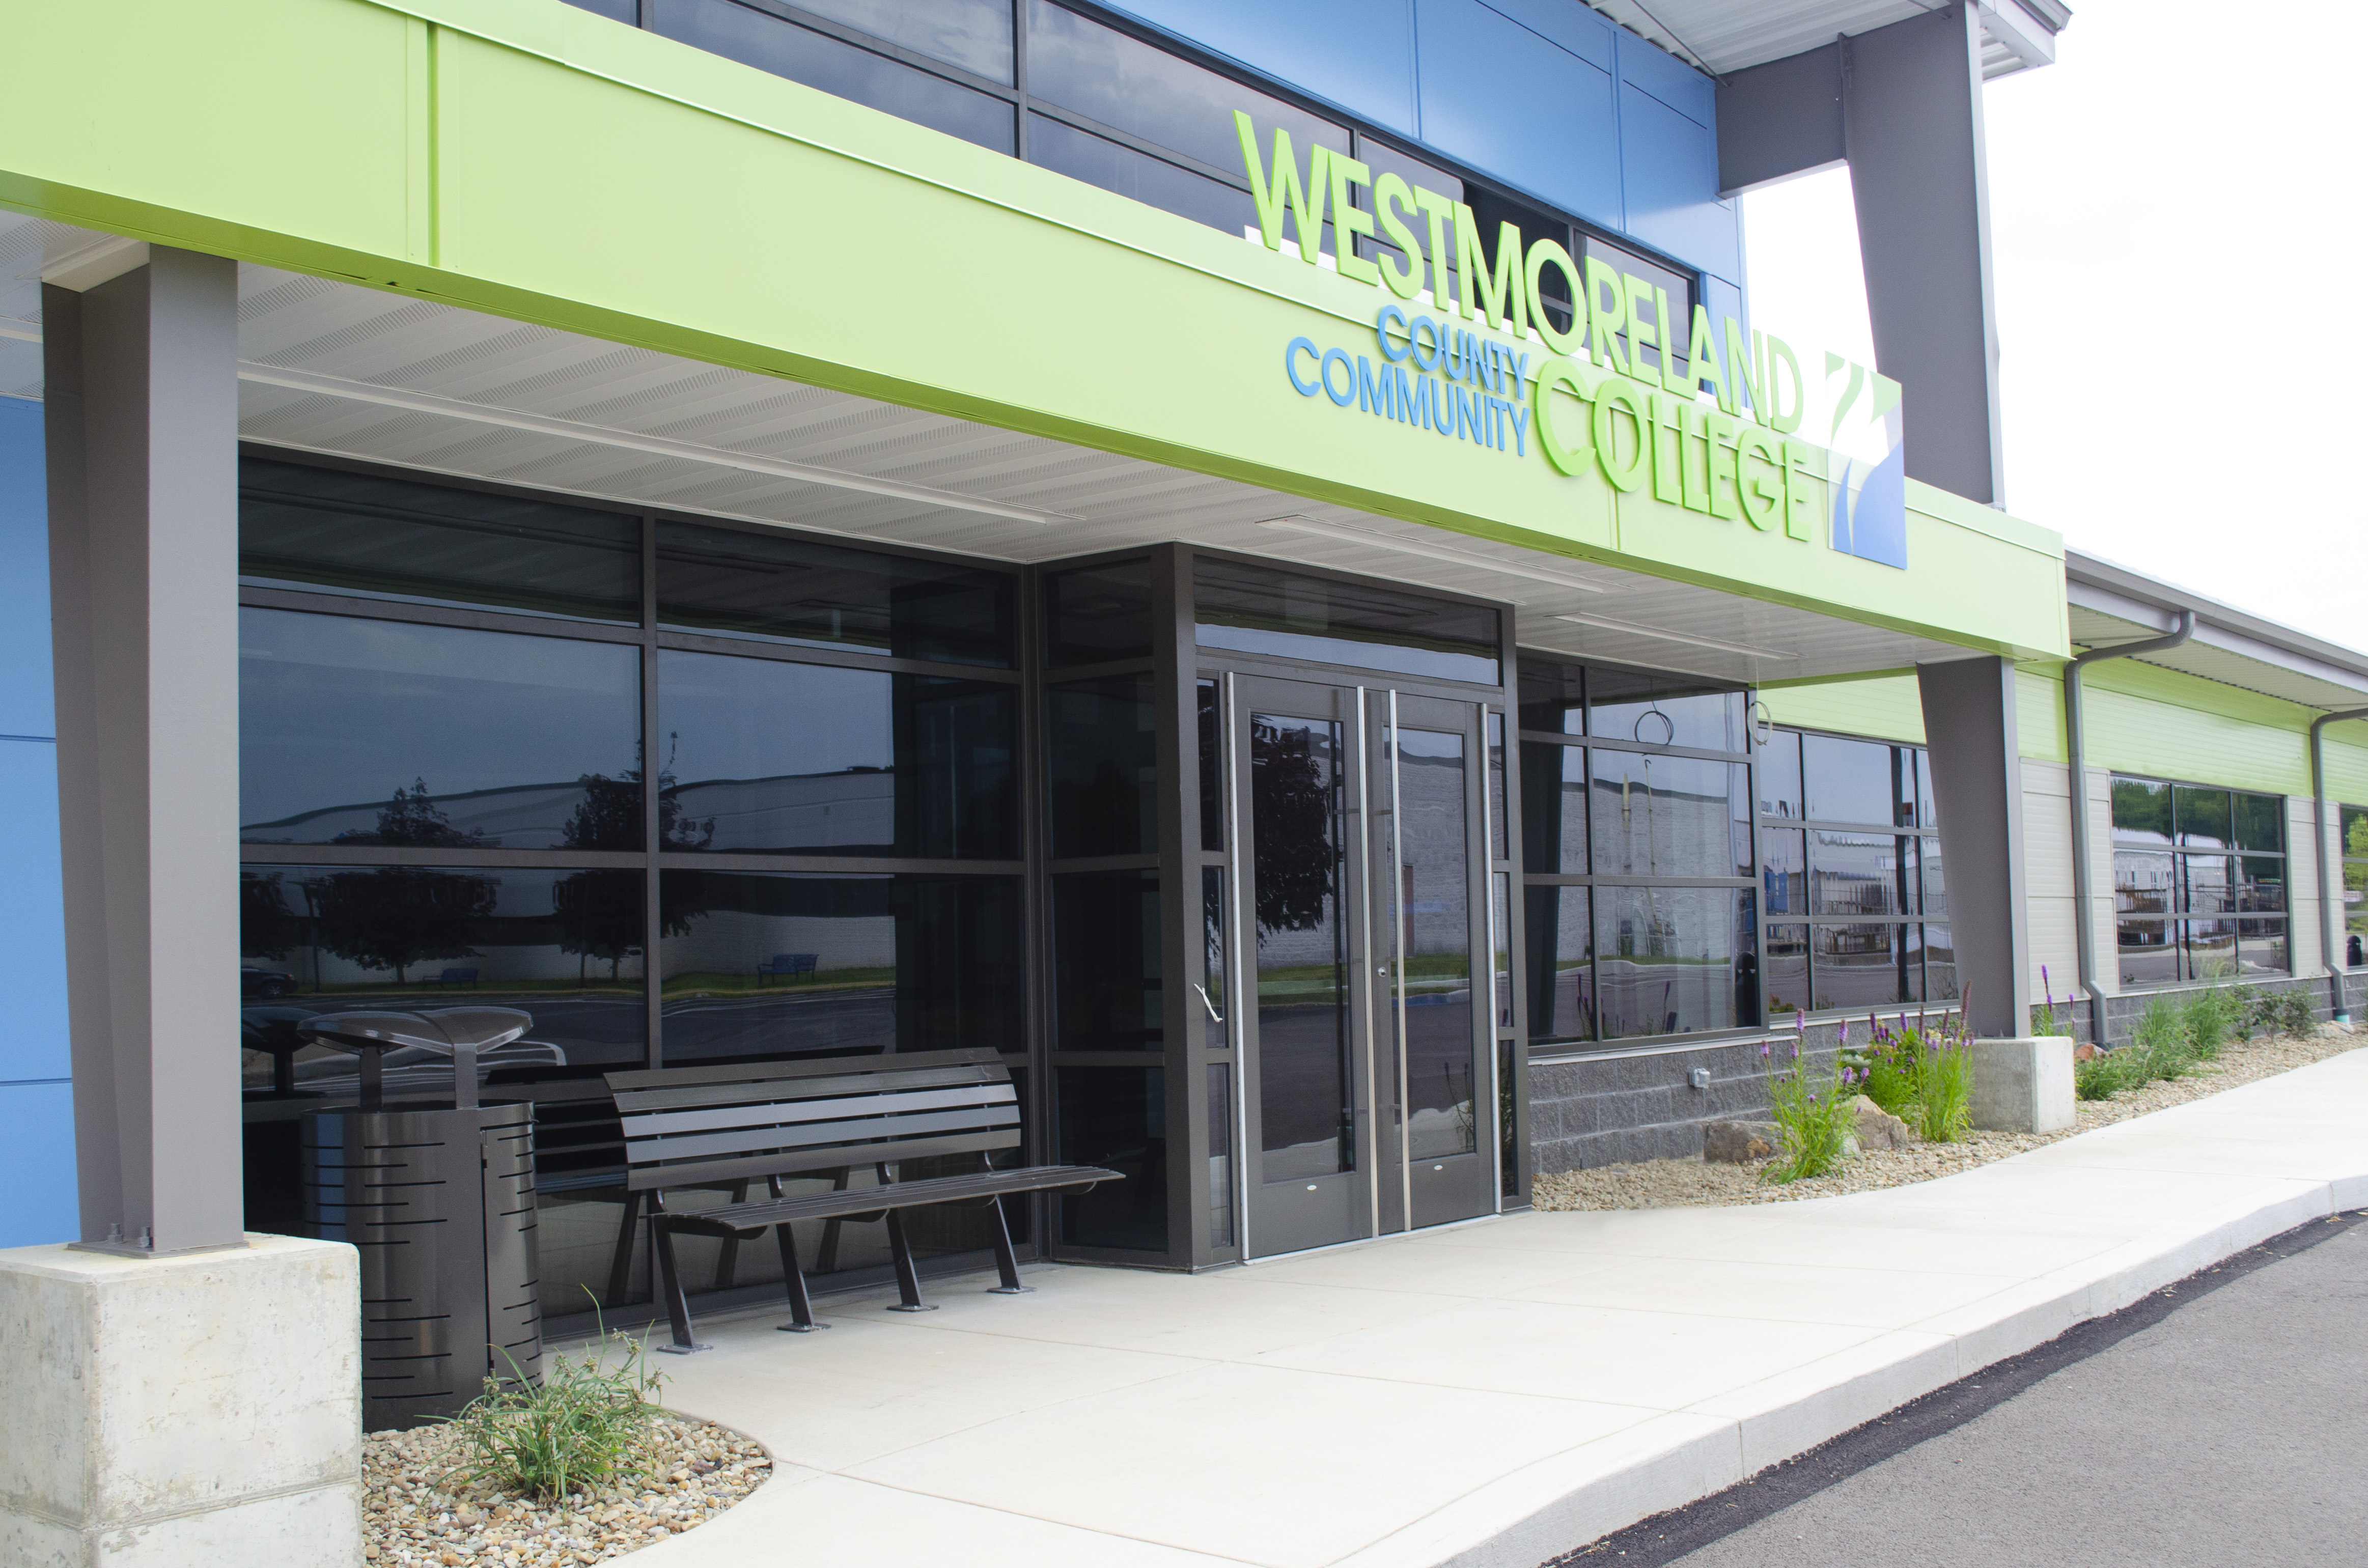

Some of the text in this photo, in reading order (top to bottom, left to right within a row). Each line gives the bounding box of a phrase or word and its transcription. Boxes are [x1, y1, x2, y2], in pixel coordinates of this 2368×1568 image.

[1233, 109, 1804, 434] WESTMORELAND
[1286, 336, 1529, 456] COMMUNITY
[1377, 304, 1528, 400] COUNTY
[1535, 359, 1811, 542] COLLEGE
